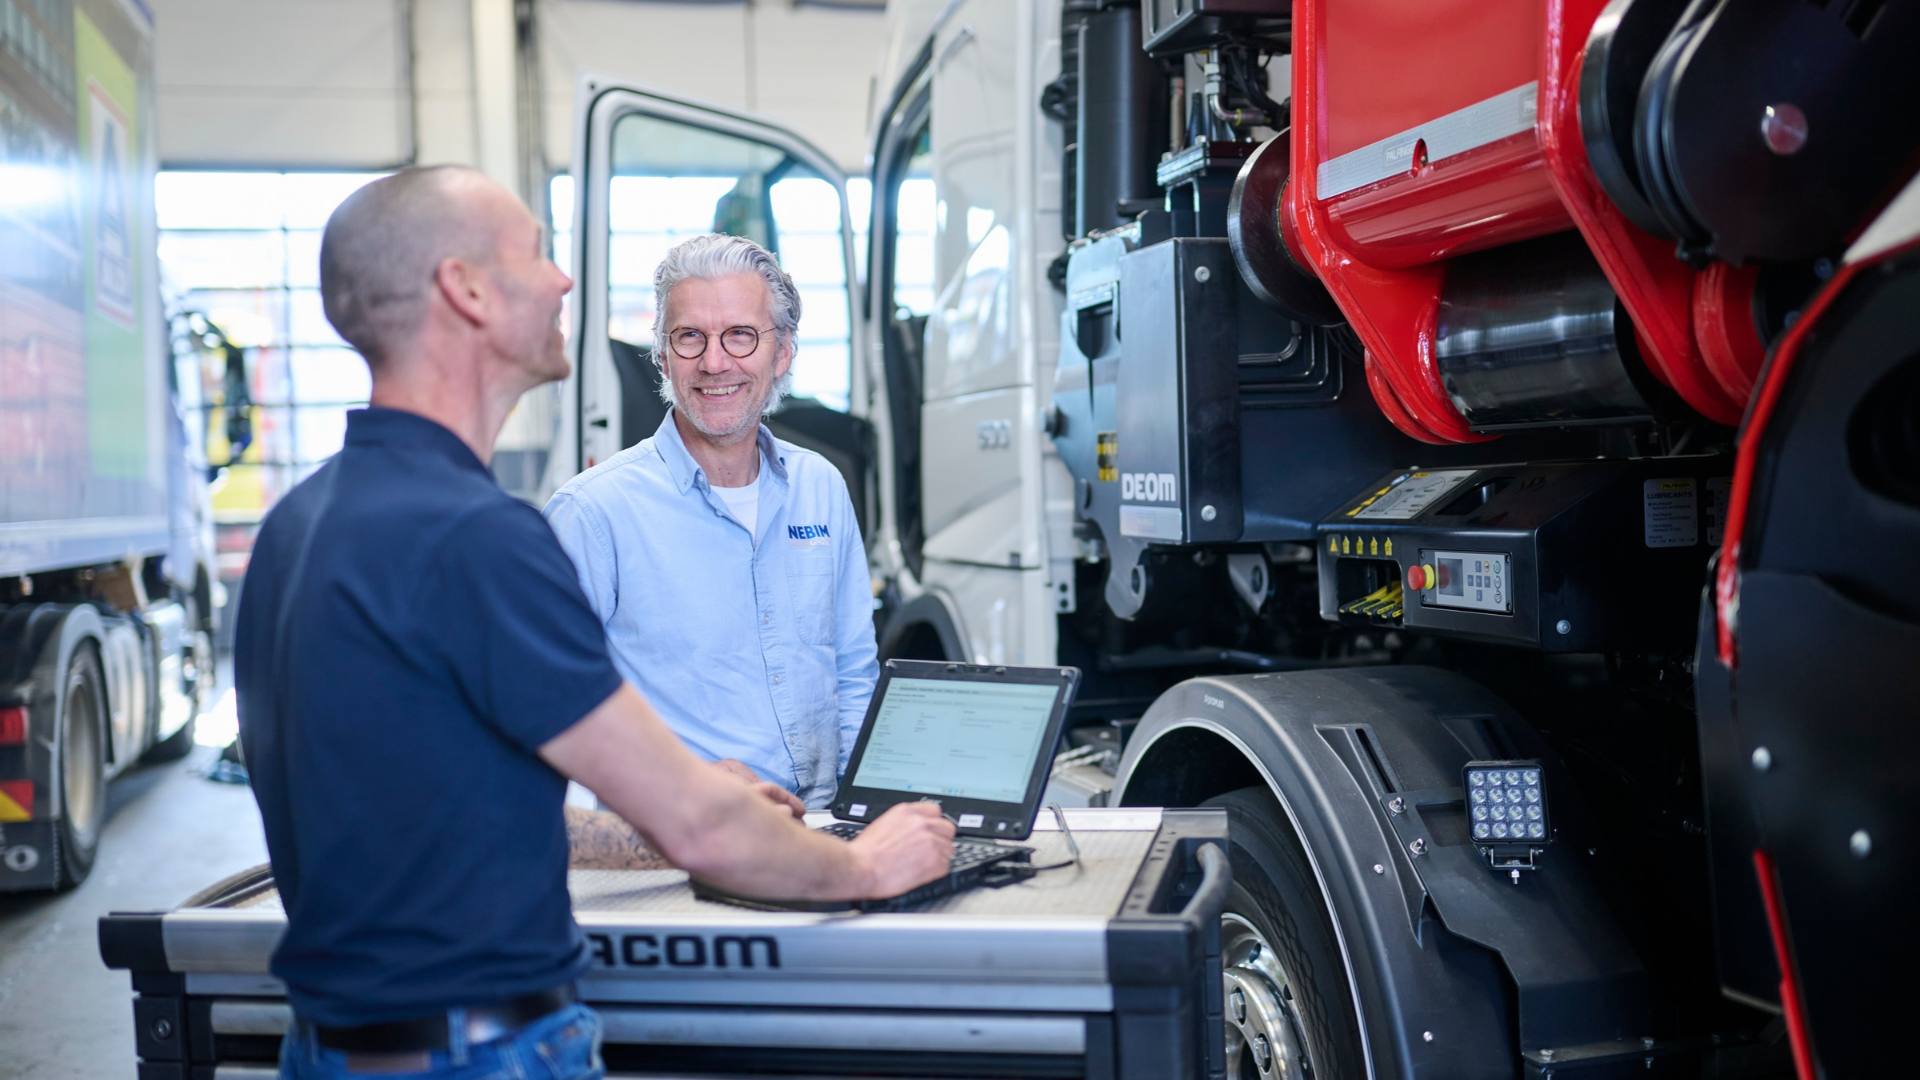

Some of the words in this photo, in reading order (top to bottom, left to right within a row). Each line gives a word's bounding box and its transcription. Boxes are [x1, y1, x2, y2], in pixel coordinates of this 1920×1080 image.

[1121, 472, 1177, 502] DEOM
[788, 524, 831, 540] NEBIM
[586, 932, 781, 968] ACOM
